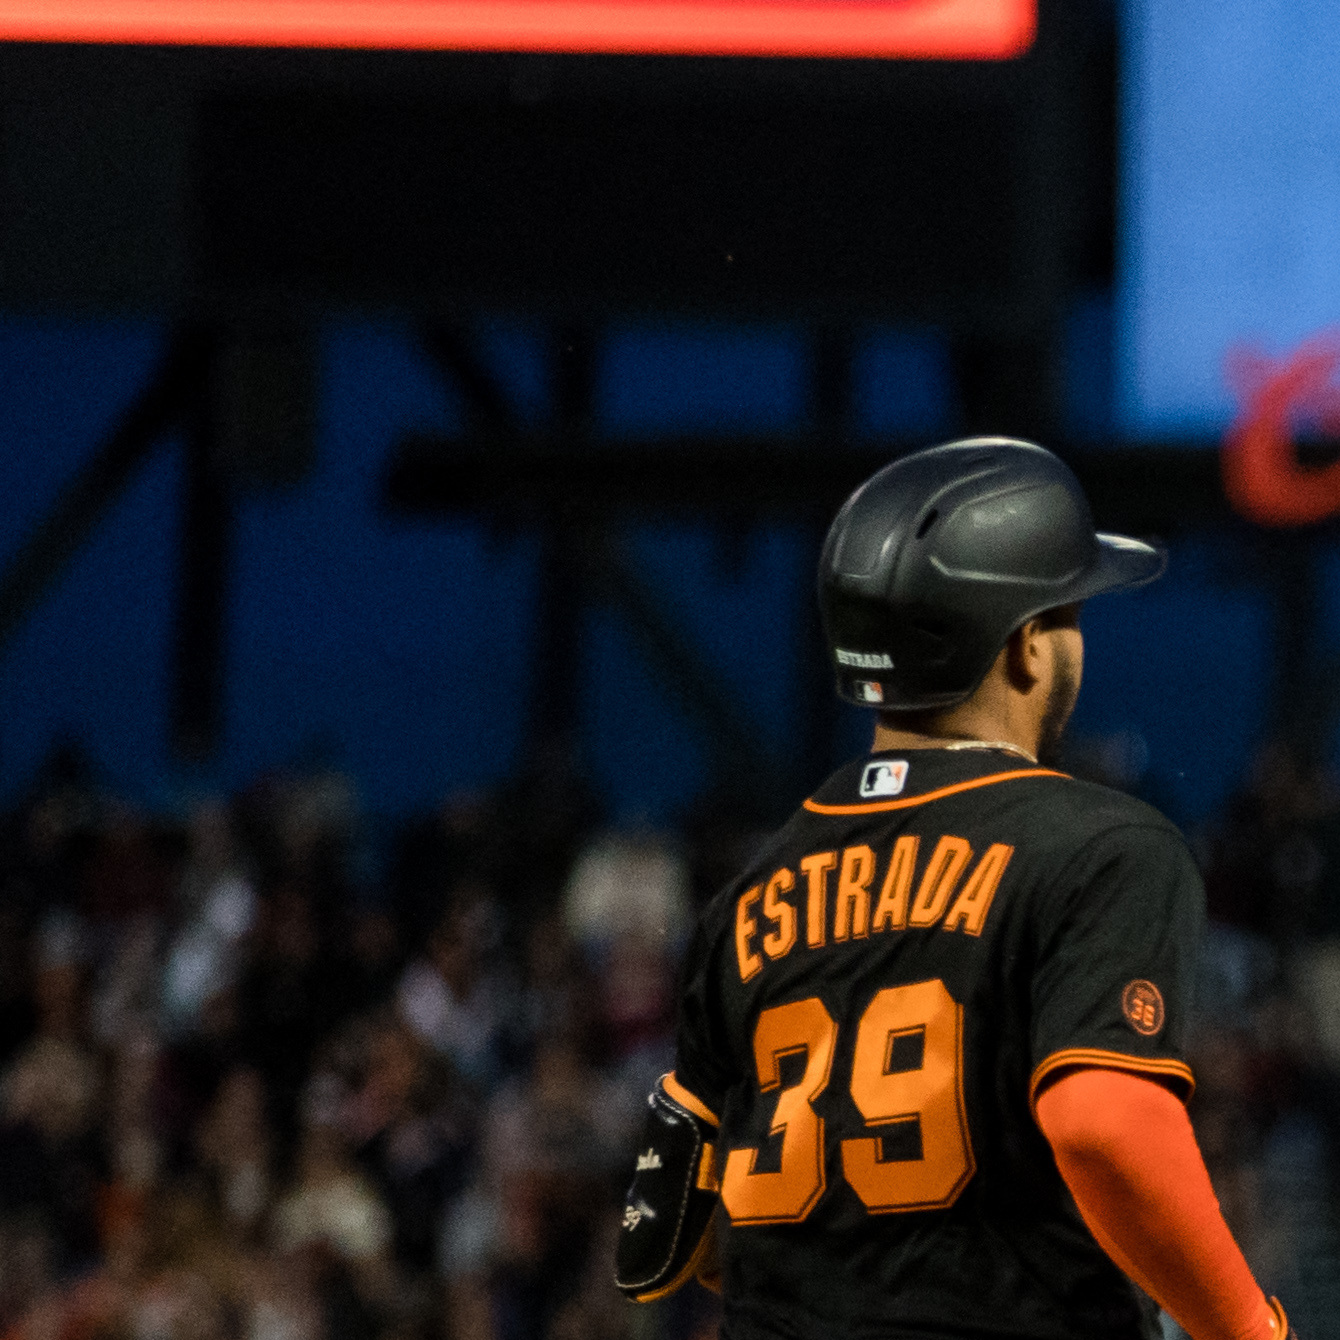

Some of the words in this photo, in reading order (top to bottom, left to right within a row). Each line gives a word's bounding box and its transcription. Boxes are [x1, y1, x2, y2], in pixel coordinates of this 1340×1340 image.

[835, 648, 894, 669] ESTRADA
[735, 835, 1014, 982] ESTRADA
[720, 978, 977, 1226] 39
